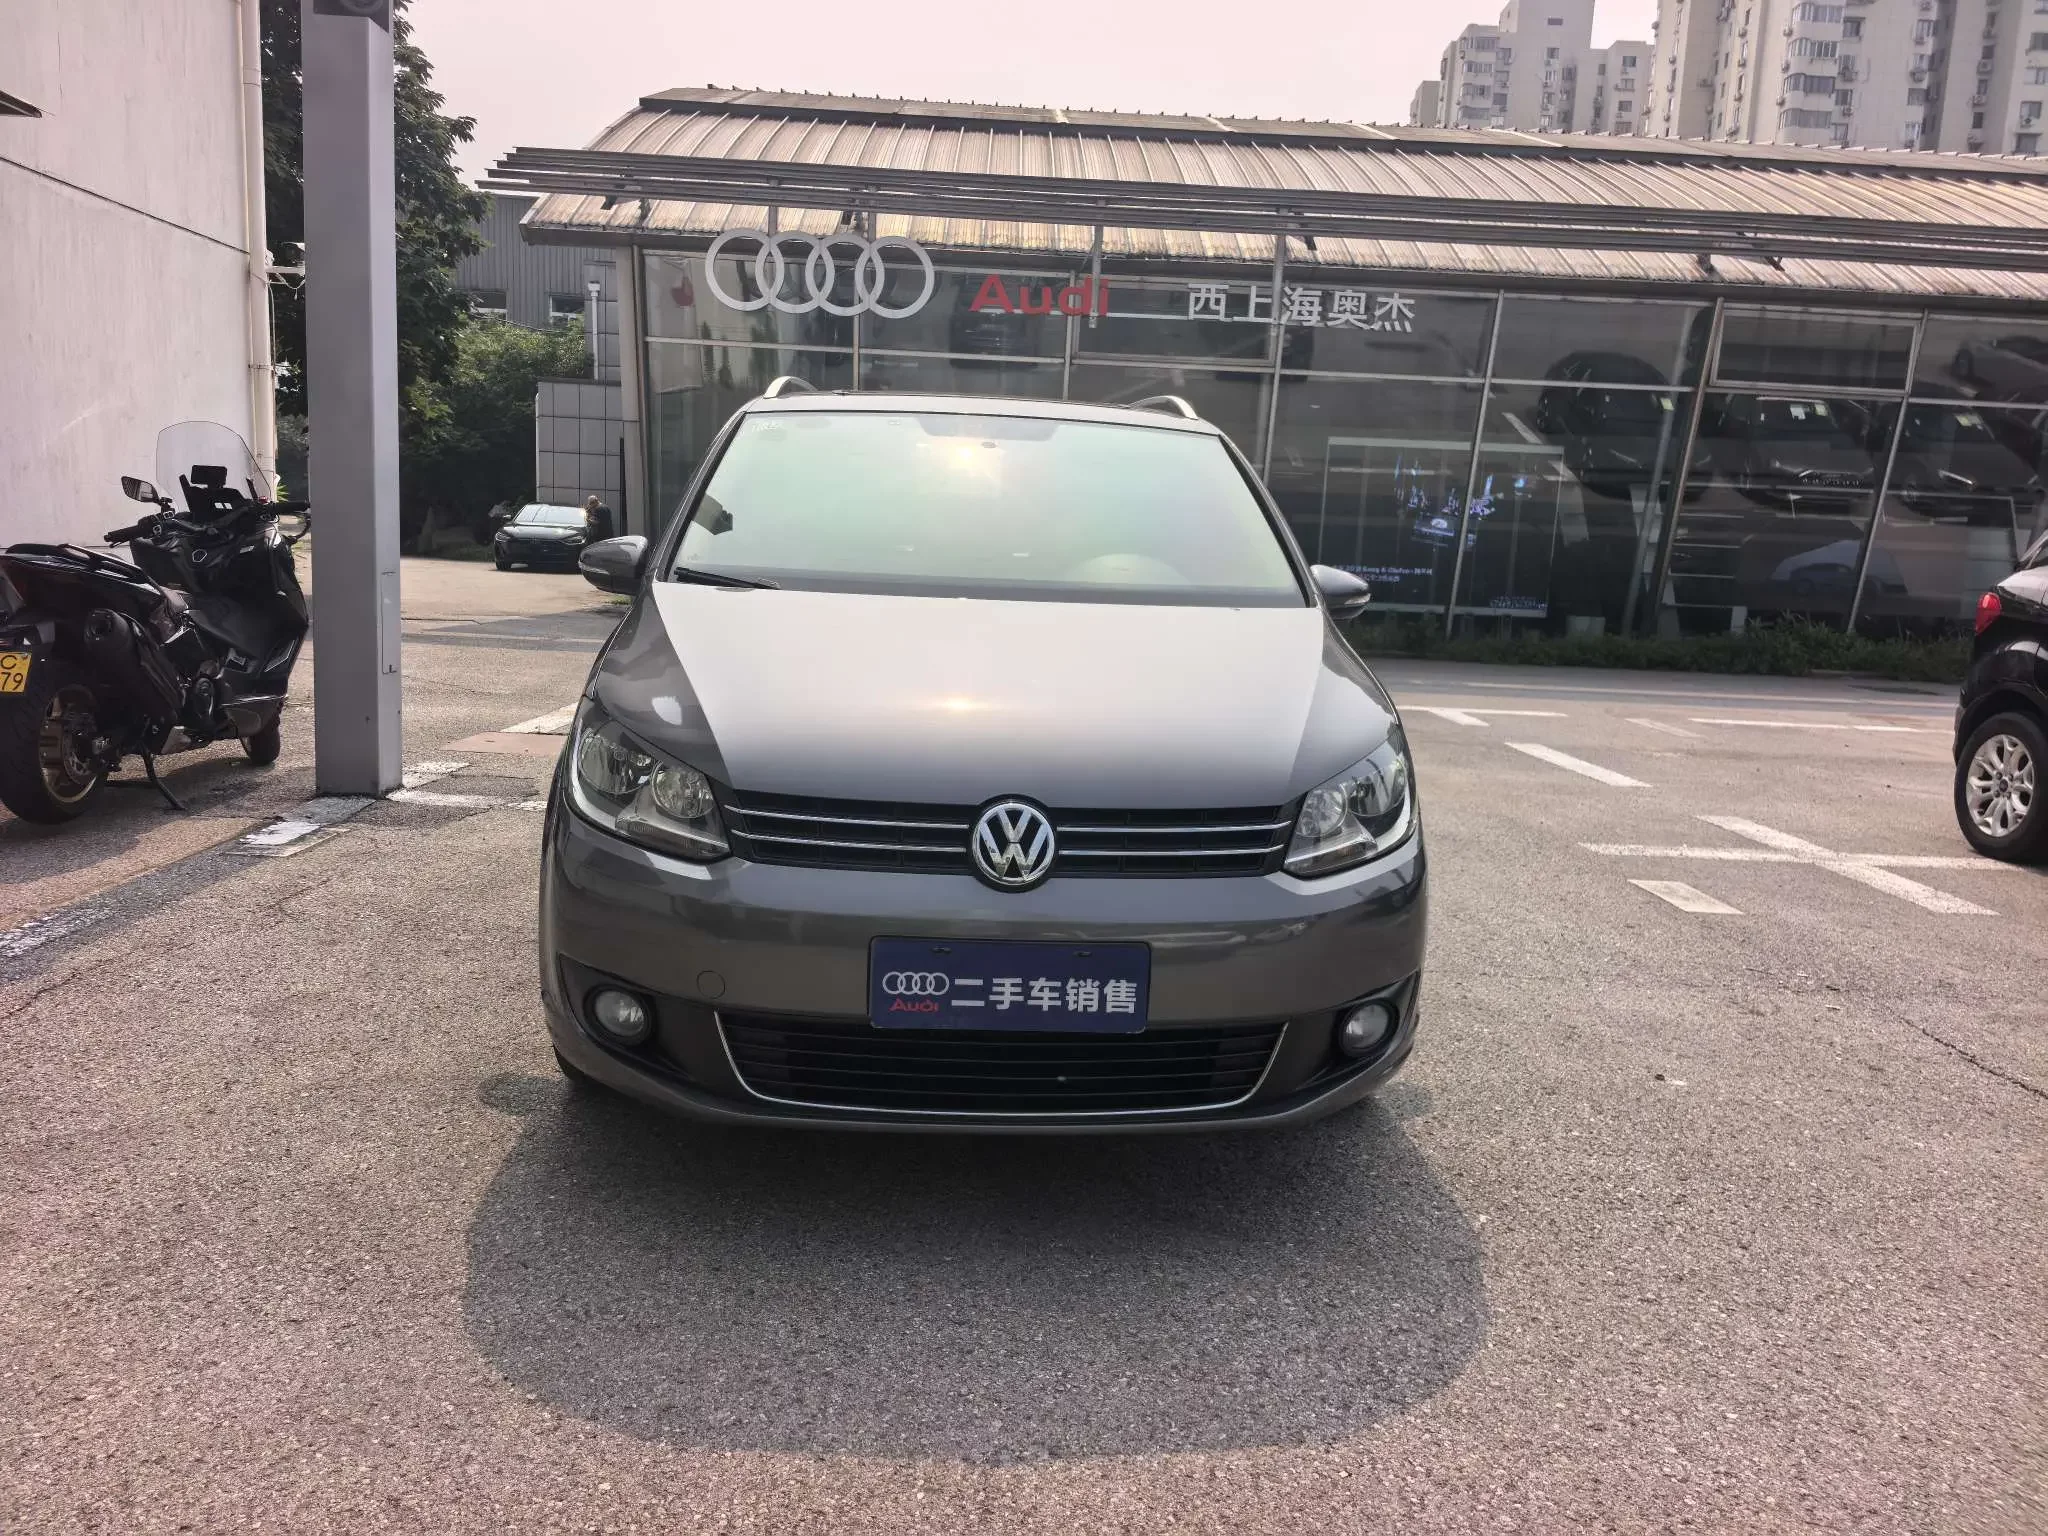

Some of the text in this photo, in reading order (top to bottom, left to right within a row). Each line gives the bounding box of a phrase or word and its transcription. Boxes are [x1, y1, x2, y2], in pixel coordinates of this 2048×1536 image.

[968, 274, 1109, 316] Audi
[1188, 283, 1415, 333] 西上海奥杰
[889, 998, 938, 1012] Audi
[951, 977, 1138, 1013] 二手车销售
